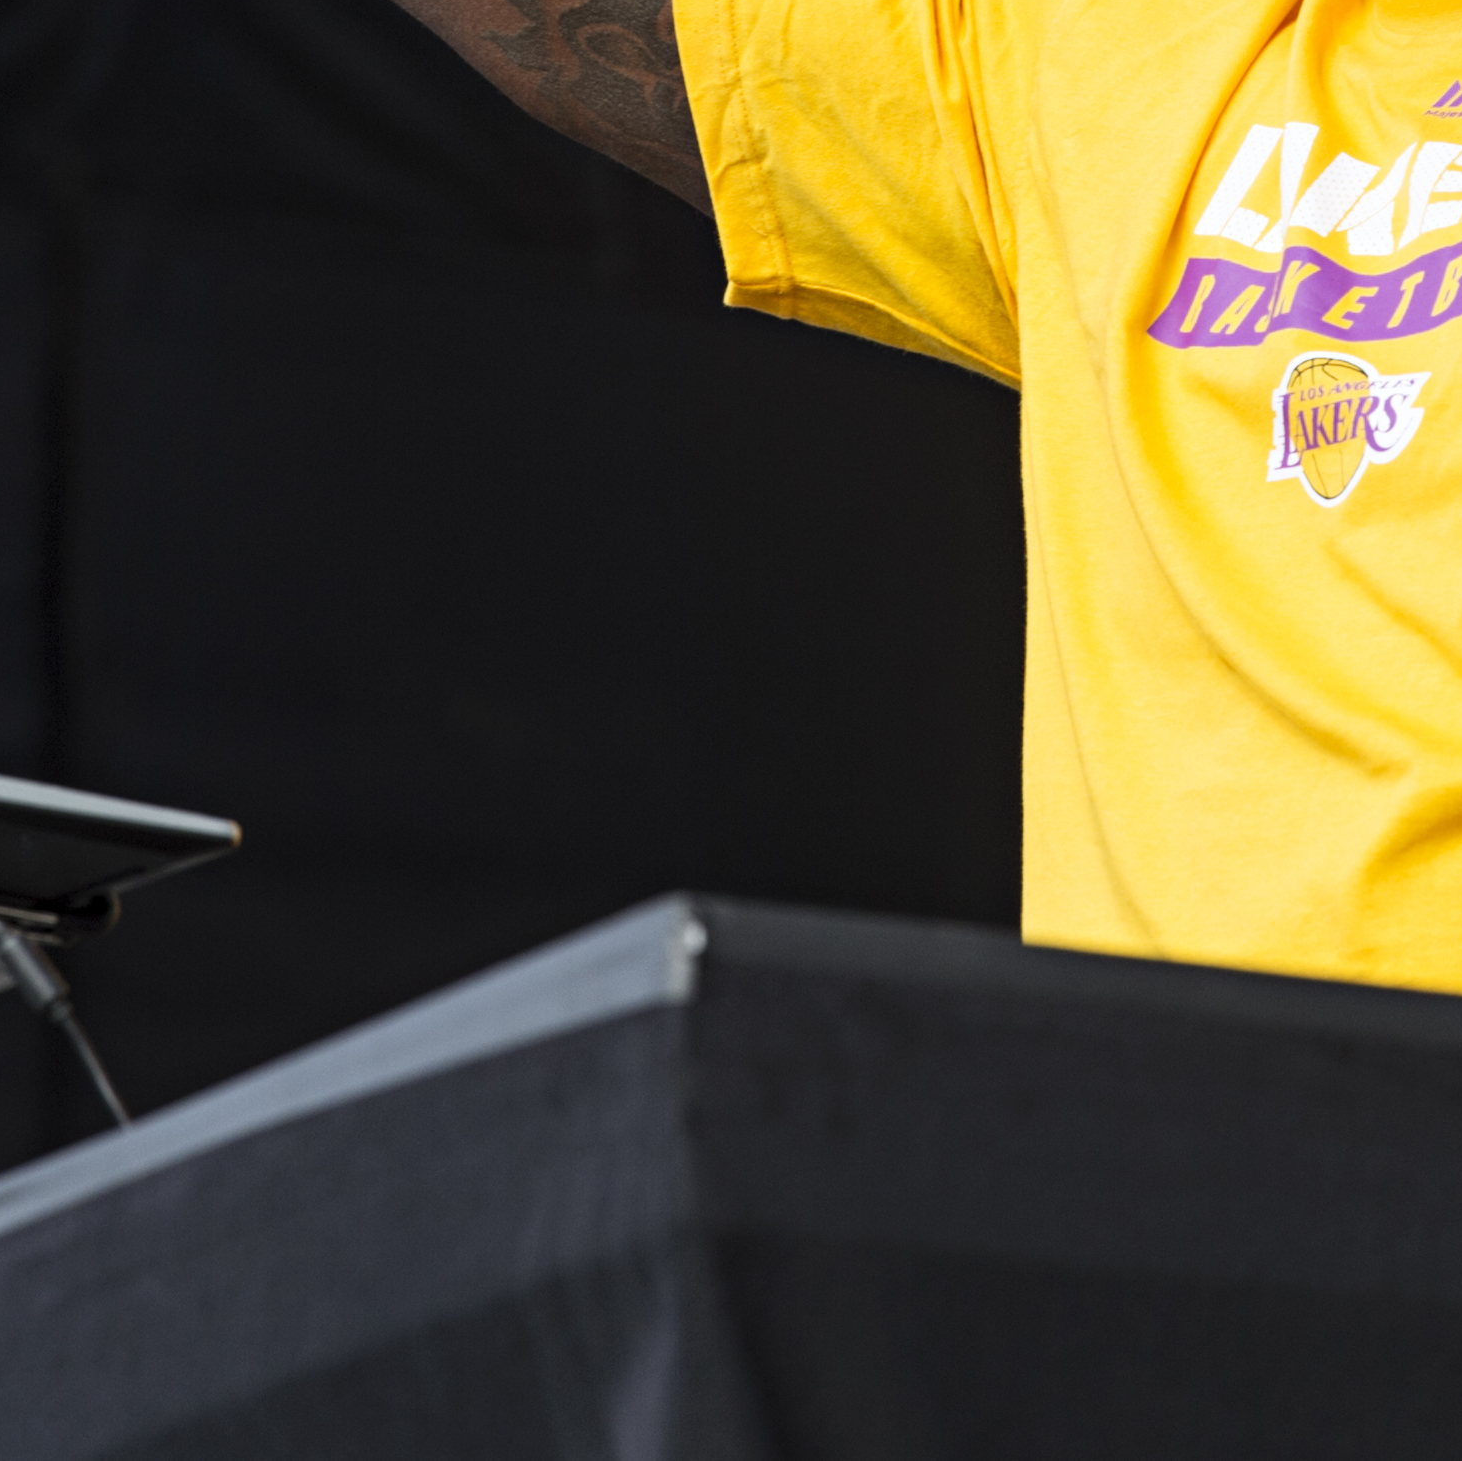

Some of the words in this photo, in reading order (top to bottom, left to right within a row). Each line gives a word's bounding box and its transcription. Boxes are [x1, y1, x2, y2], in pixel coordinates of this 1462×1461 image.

[1299, 385, 1325, 402] LOS
[1327, 377, 1419, 396] ANGELES
[1274, 392, 1412, 470] LAKERS
